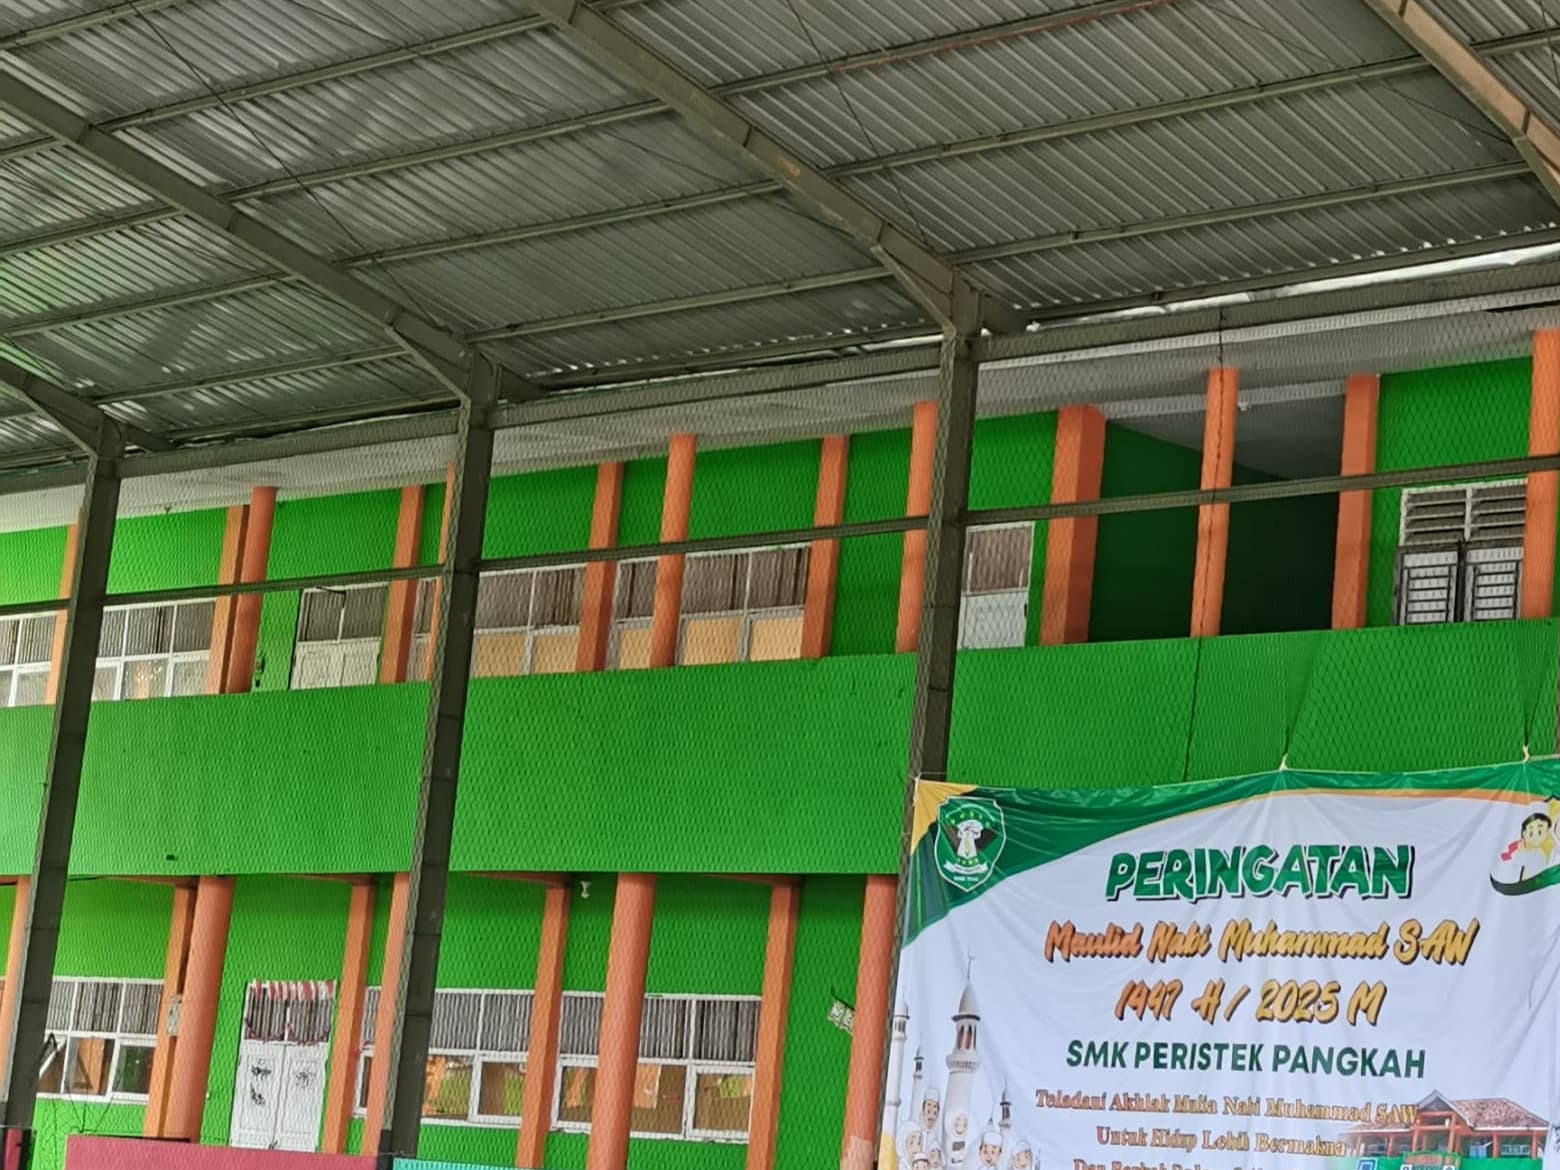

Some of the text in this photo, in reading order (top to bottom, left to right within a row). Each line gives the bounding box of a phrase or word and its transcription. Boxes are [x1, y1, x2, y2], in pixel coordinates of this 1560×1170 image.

[1104, 845, 1415, 904] PERINGATAN
[1044, 917, 1480, 965] Maulid Nabi Muhammad SAW
[1114, 979, 1183, 1021] 1447
[1255, 979, 1341, 1024] 2025
[1346, 980, 1387, 1025] M
[1066, 1039, 1426, 1078] SMK PERISTEK PANGKAH
[1035, 1089, 1107, 1110] Teladani
[1109, 1092, 1170, 1113] Akhlak
[1172, 1094, 1218, 1114] Mulia
[1222, 1096, 1261, 1117] Nabi
[1265, 1097, 1371, 1122] Muhammad
[1096, 1126, 1346, 1157] Untuk Hidup Lebih Bermakna
